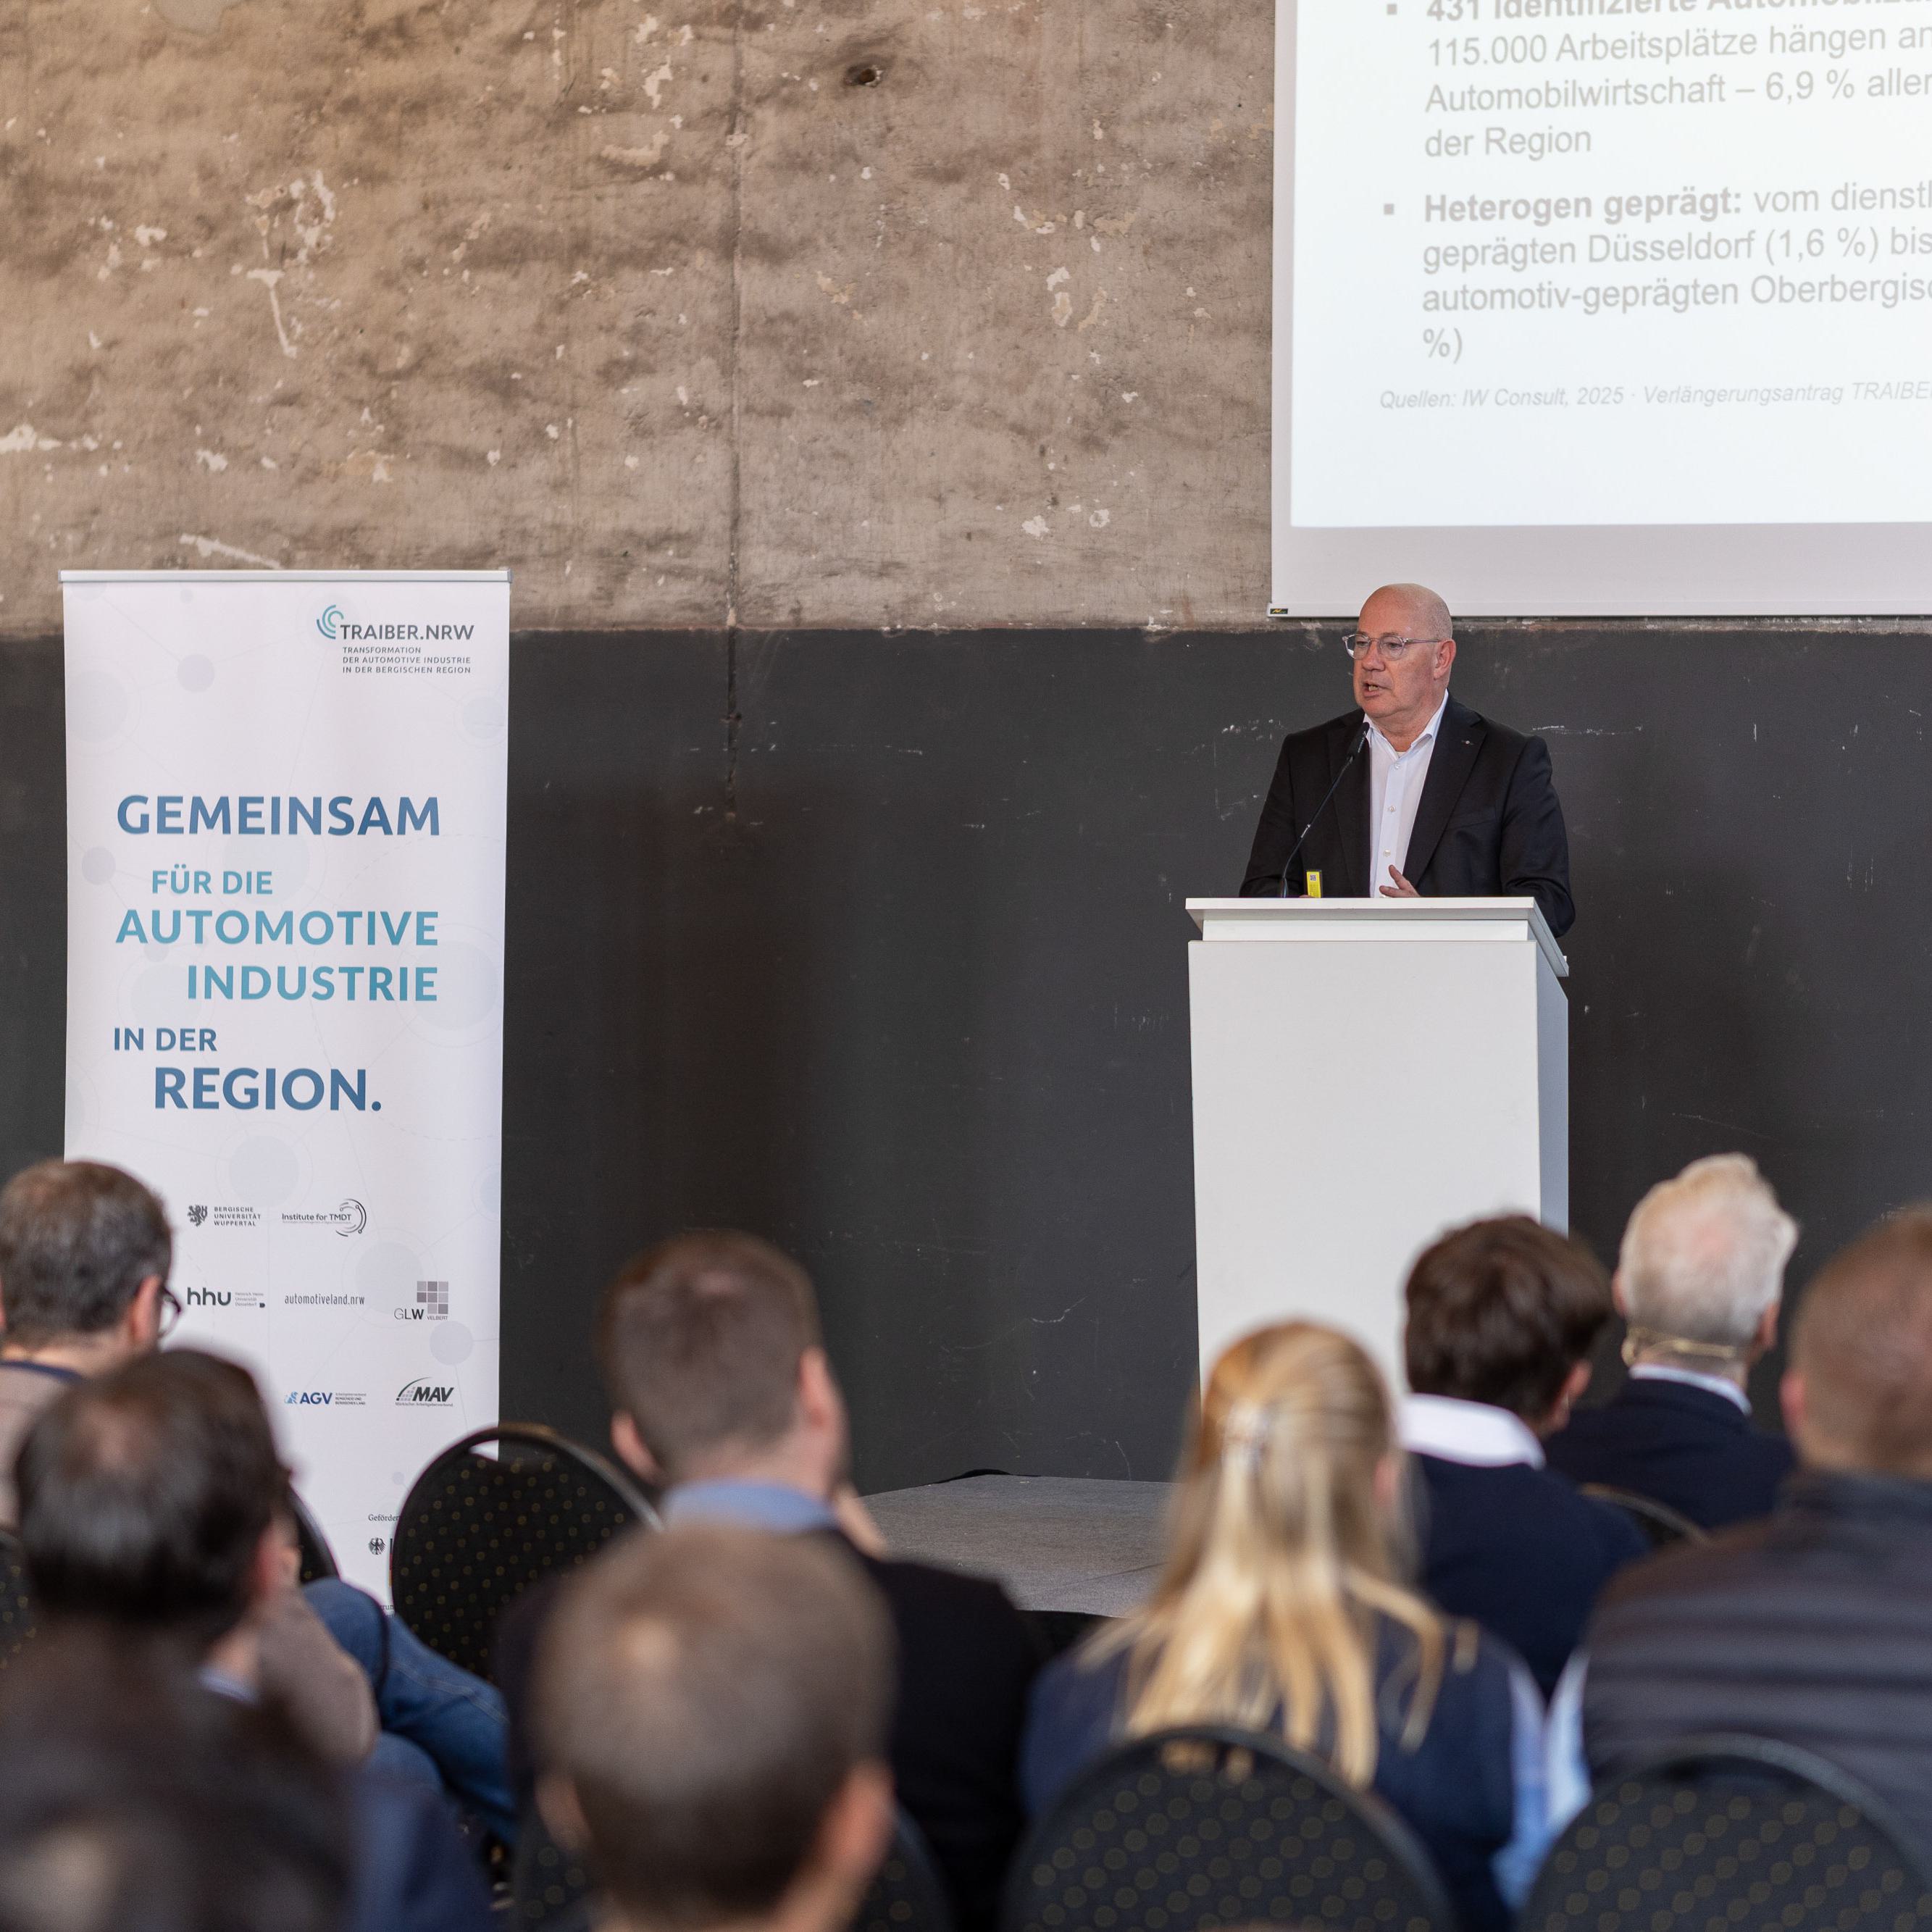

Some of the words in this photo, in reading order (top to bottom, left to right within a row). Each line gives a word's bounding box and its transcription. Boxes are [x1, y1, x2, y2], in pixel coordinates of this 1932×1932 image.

[1429, 35, 1547, 66] 115.000
[1555, 28, 1757, 64] Arbeitsplätze
[1770, 24, 1886, 59] hängen
[1426, 74, 1726, 112] Automobilwirtschaft
[1766, 71, 1813, 104] 6,9
[1826, 69, 1854, 99] %
[1425, 129, 1474, 157] der
[1486, 125, 1591, 161] Region
[1426, 194, 1592, 227] Heterogen
[1604, 186, 1741, 225] geprägt:
[1754, 191, 1818, 212] vom
[1831, 180, 1932, 211] dienstl
[1423, 237, 1576, 275] geprägten
[1589, 230, 1755, 262] Düsseldorf
[1766, 229, 1824, 266] (1,6
[1838, 227, 1878, 263] %)
[1891, 226, 1932, 255] bis
[1423, 277, 1738, 315] automotiv-geprägten
[1751, 272, 1932, 309] Oberbergis
[1423, 328, 1463, 364] %)
[1380, 390, 1456, 409] Quellen:
[1463, 389, 1489, 406] IW
[1494, 388, 1568, 407] Consult,
[1577, 387, 1623, 405] 2025
[1644, 385, 1843, 407] Verlängerungsantrag
[1852, 381, 1932, 400] TRAIBE
[340, 624, 474, 640] TRAIBER.NRW
[117, 795, 439, 835] GEMEINSAM
[153, 864, 212, 894] FÜR
[223, 871, 272, 894] DIE
[116, 910, 438, 945] AUTOMOTIVE
[188, 966, 438, 1001] INDUSTRIE
[114, 1028, 143, 1050] IN
[156, 1028, 217, 1051] DER
[156, 1067, 381, 1111] REGION.
[315, 1213, 328, 1221] for
[188, 1287, 231, 1305] hhu
[285, 1294, 364, 1305] automotiveland.nrw
[394, 1308, 424, 1319] GLW
[300, 1392, 333, 1404] AGV
[412, 1387, 453, 1402] MAV
